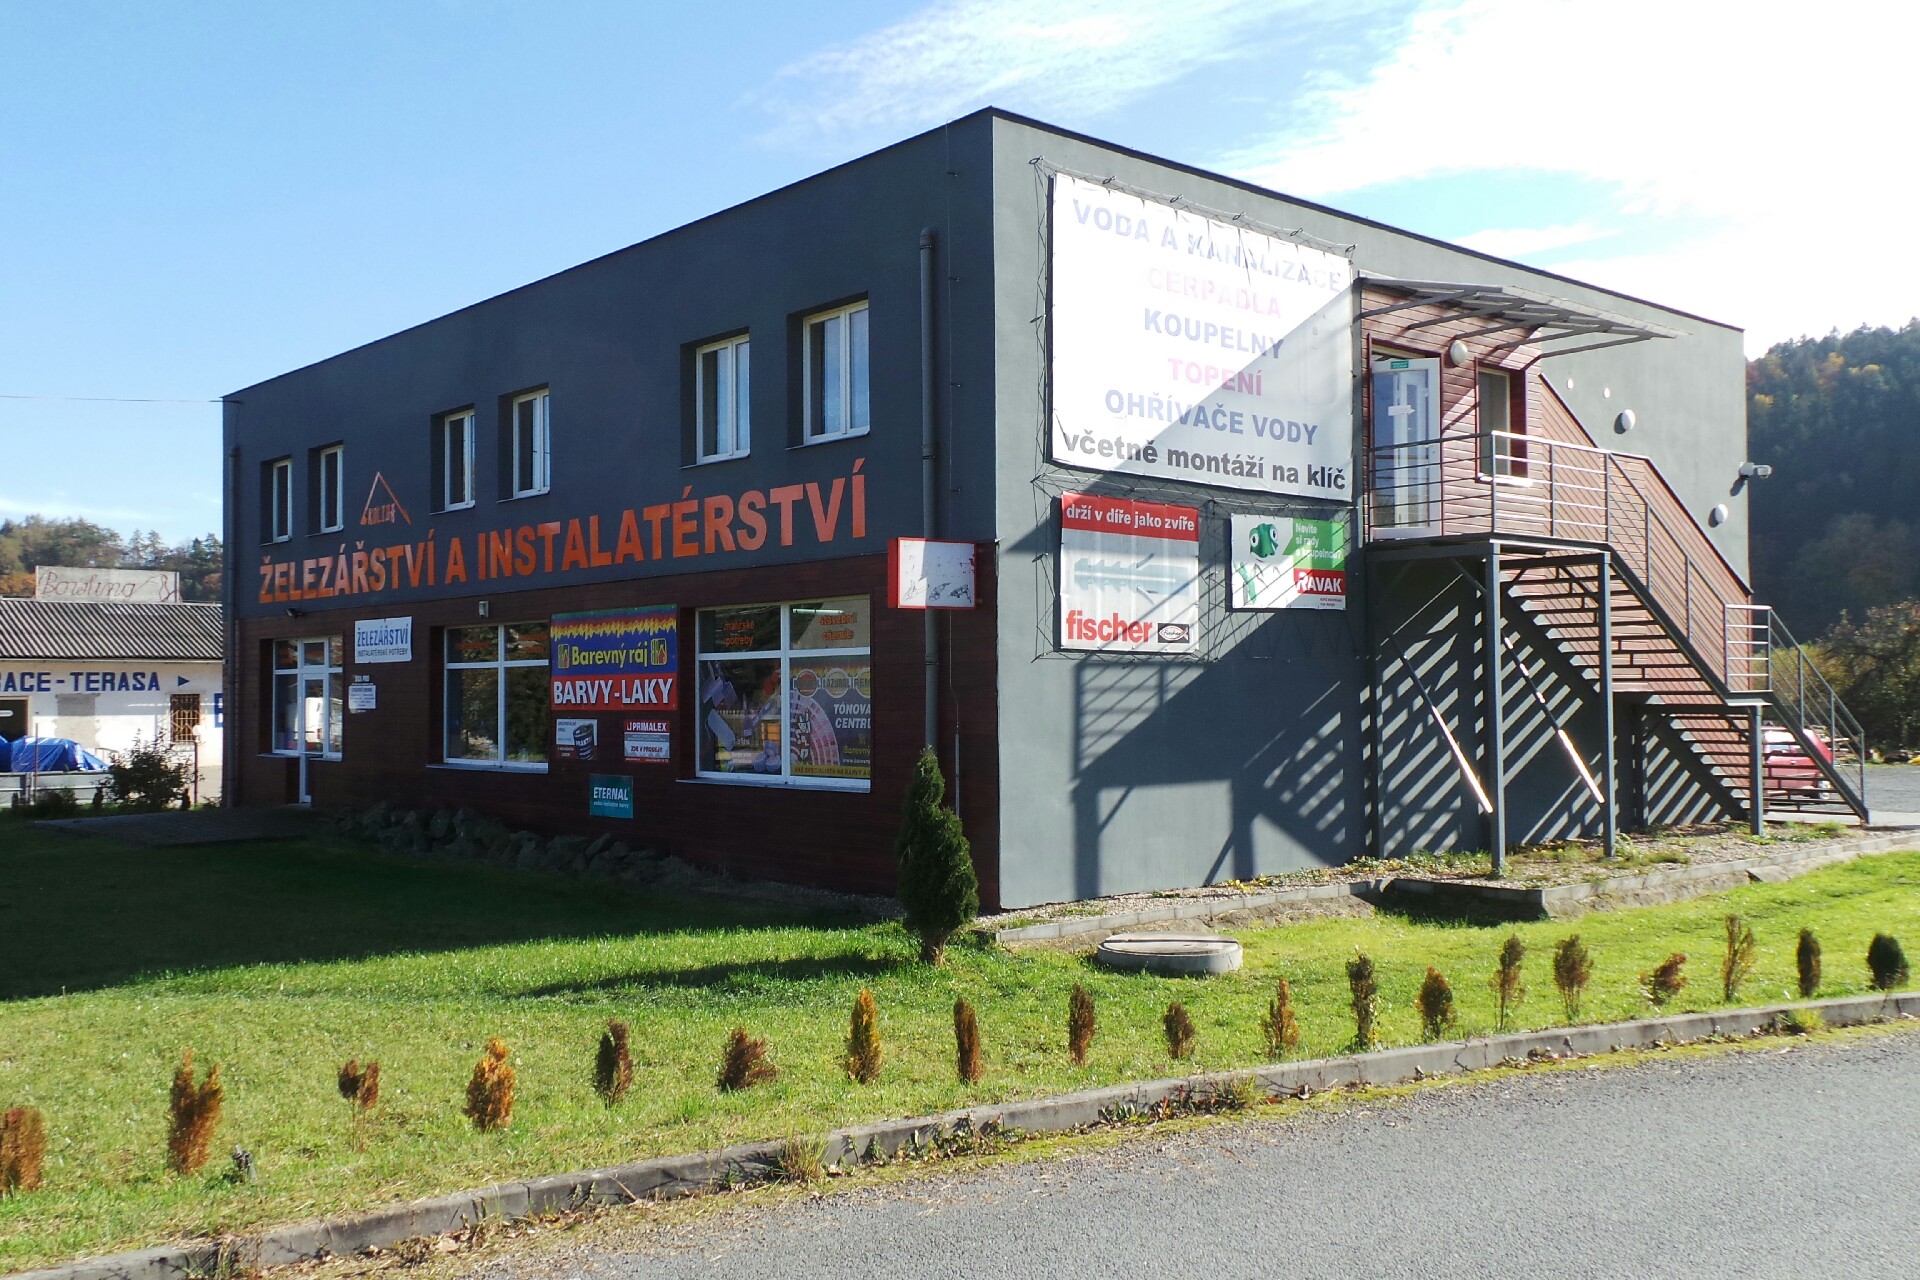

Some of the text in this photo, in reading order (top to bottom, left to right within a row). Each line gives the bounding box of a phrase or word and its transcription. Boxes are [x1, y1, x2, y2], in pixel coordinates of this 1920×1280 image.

[1072, 198, 1150, 243] VODA
[1160, 225, 1178, 250] A
[1144, 307, 1285, 359] KOUPELNY
[1167, 357, 1263, 397] TOPENÍ
[1104, 389, 1319, 446] OHŘÍVAČE VODY
[1066, 429, 1347, 490] včetně montáží na klíč
[258, 457, 867, 604] ŽELEZÁŘSTVÍ A INSTALATÉRSTVÍ
[1066, 503, 1196, 532] drží v díře jako zvíře
[38, 571, 137, 601] Bowling
[1296, 571, 1342, 593] RAVAK
[357, 623, 409, 647] ŽELEZÁŘSTVÍ
[1066, 609, 1153, 644] fischer
[571, 640, 648, 669] Barevný ráj
[0, 671, 51, 692] ACE
[70, 671, 161, 692] TERASA
[632, 722, 667, 732] PRIMALEX
[593, 786, 629, 801] ETERNAL
